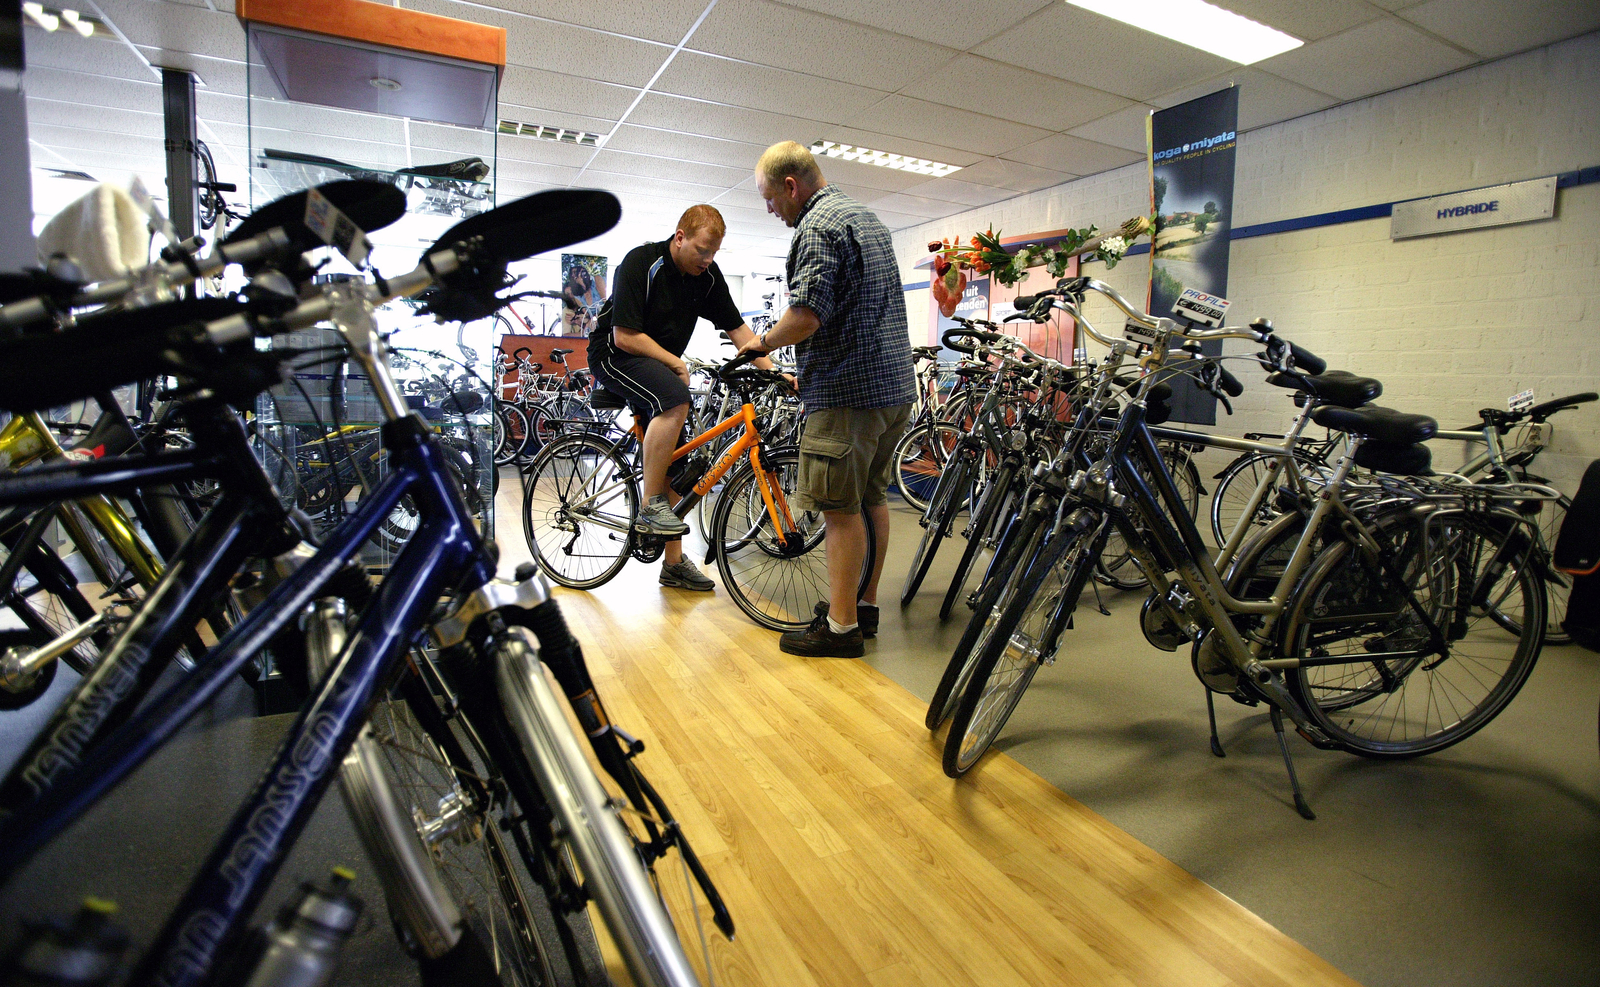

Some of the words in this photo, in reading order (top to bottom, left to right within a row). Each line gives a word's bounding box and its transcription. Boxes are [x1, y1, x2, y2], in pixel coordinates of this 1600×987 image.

[1154, 146, 1182, 160] koga
[1190, 131, 1236, 151] miyata
[1161, 156, 1182, 166] QUALITY
[1183, 150, 1203, 159] PEOPLE
[1212, 141, 1236, 153] CYCLING
[1436, 200, 1499, 219] HYBRIDE
[966, 284, 979, 297] uit
